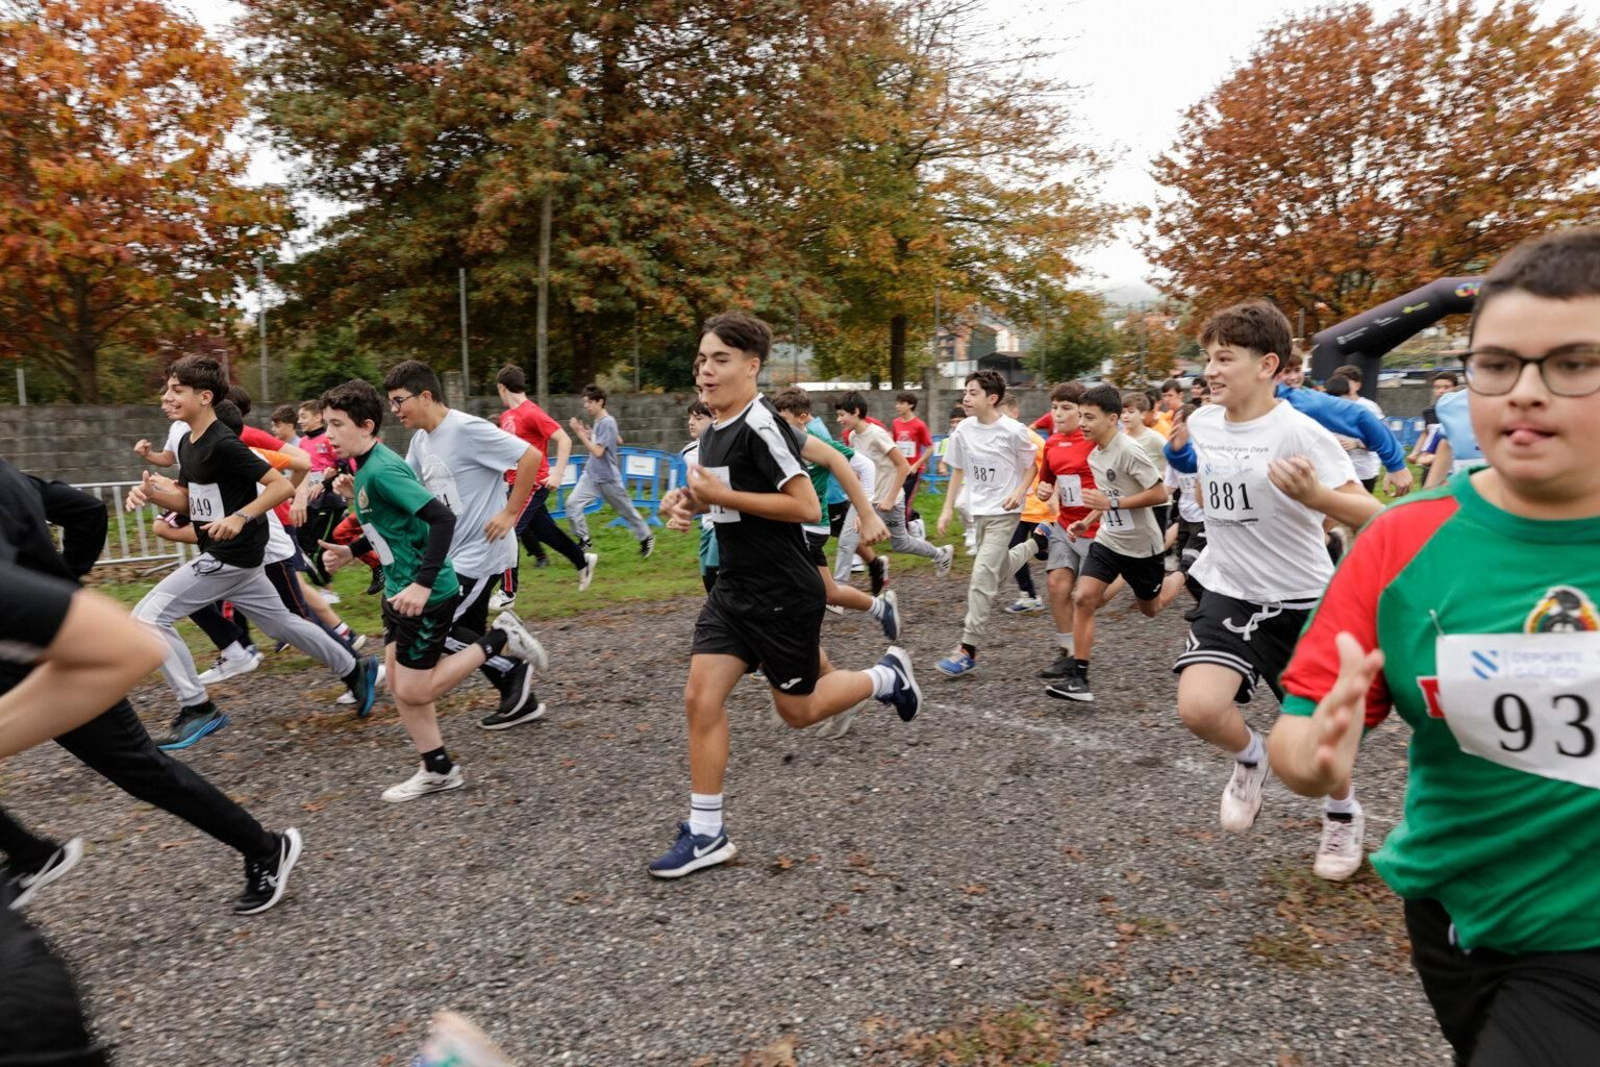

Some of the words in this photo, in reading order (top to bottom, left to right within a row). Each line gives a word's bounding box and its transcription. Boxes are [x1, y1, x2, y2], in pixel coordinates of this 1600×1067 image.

[973, 465, 996, 483] 887
[1209, 480, 1254, 512] 881
[1492, 692, 1597, 759] 93
